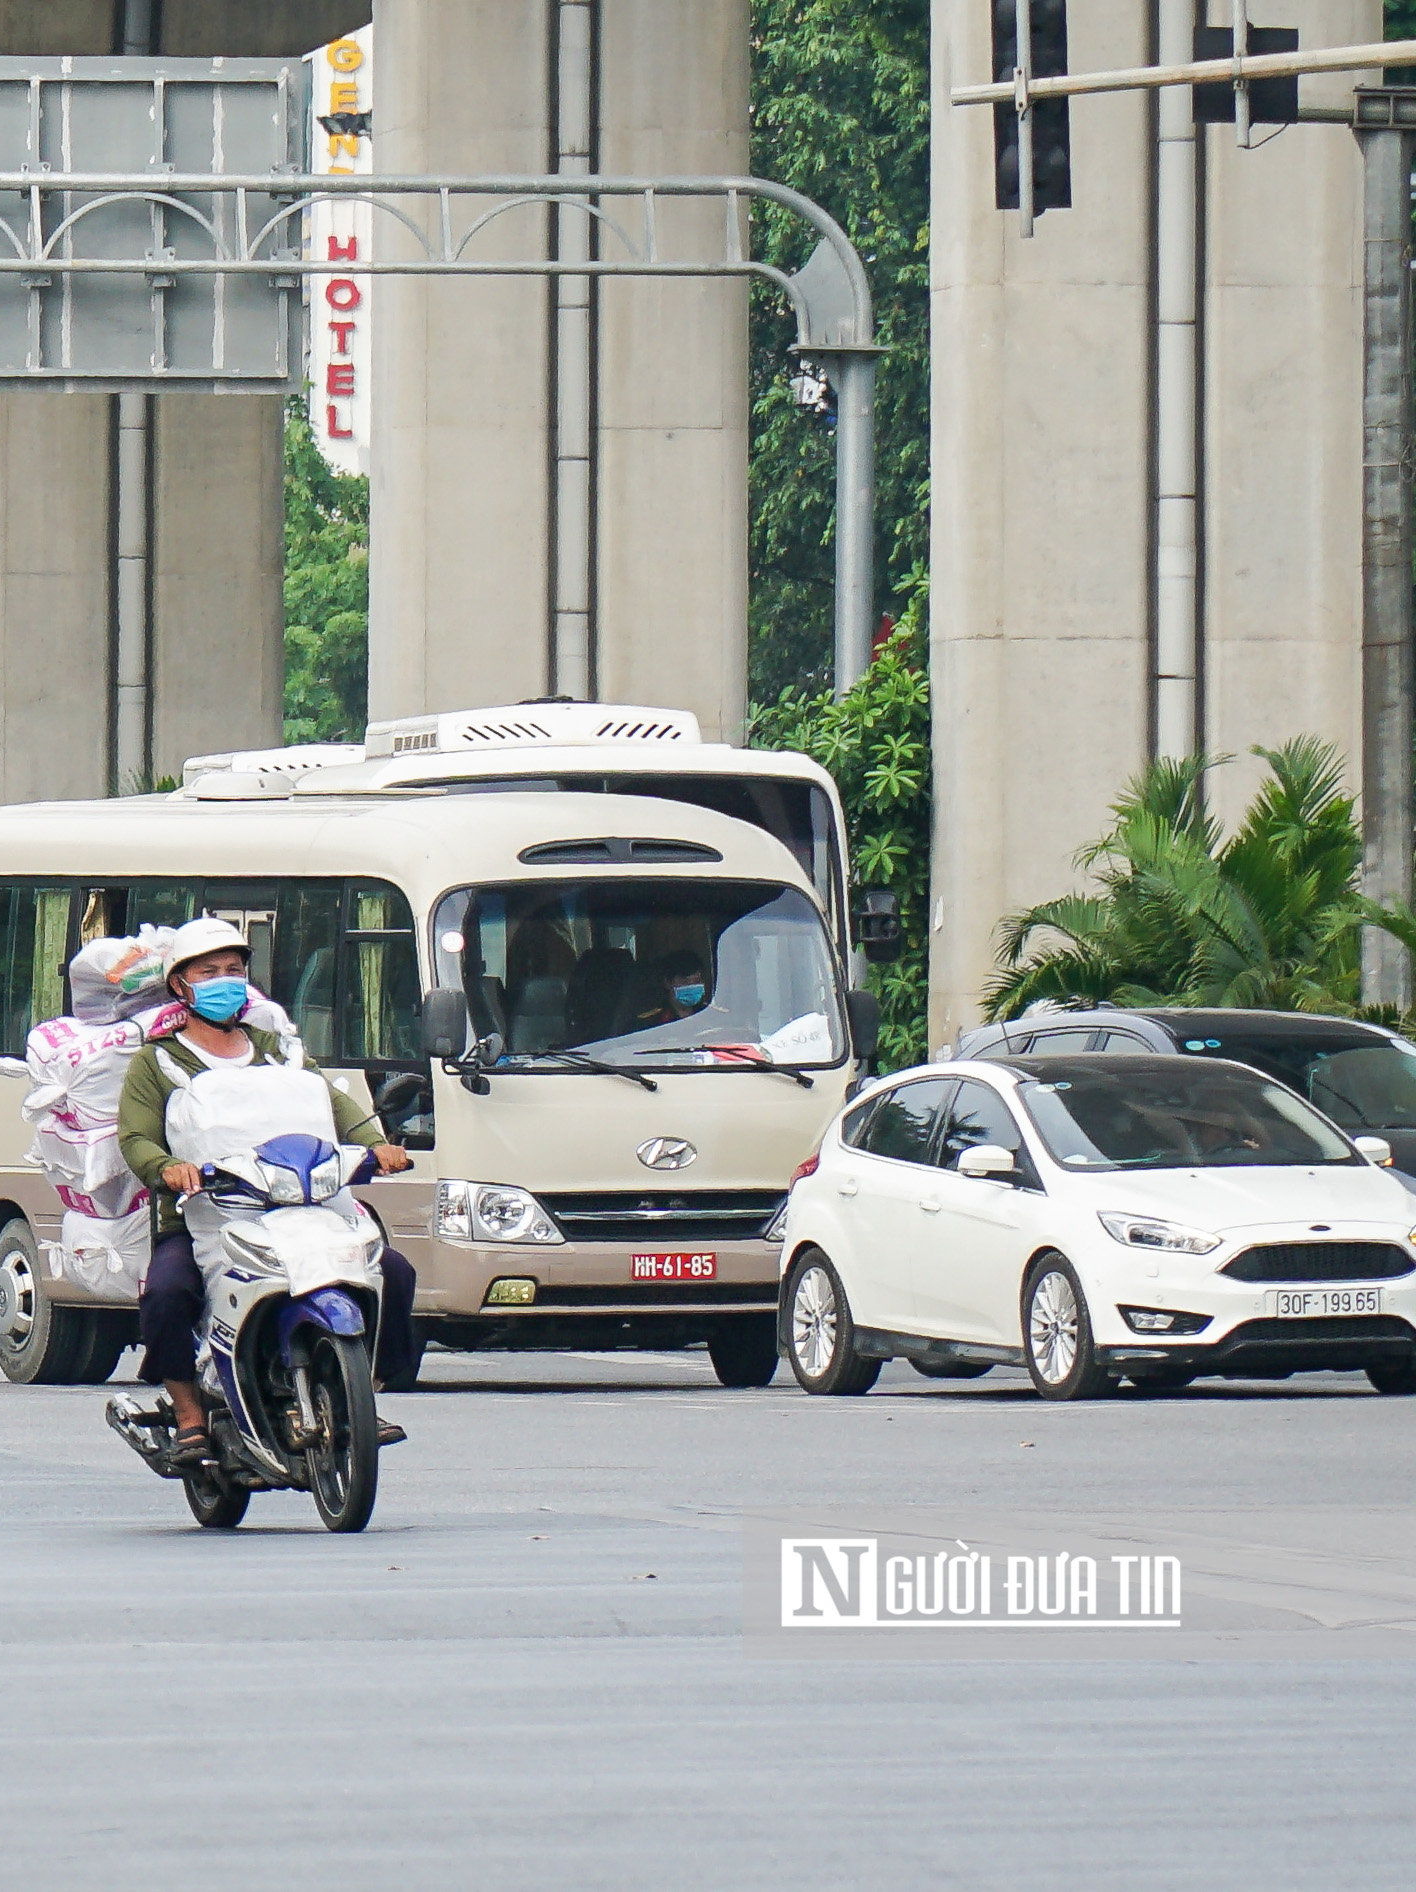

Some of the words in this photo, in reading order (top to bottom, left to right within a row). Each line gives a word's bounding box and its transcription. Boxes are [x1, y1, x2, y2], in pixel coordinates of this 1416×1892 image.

[326, 39, 364, 175] GEN
[325, 235, 361, 439] HOTEL
[1280, 1291, 1376, 1314] 30F-199.65
